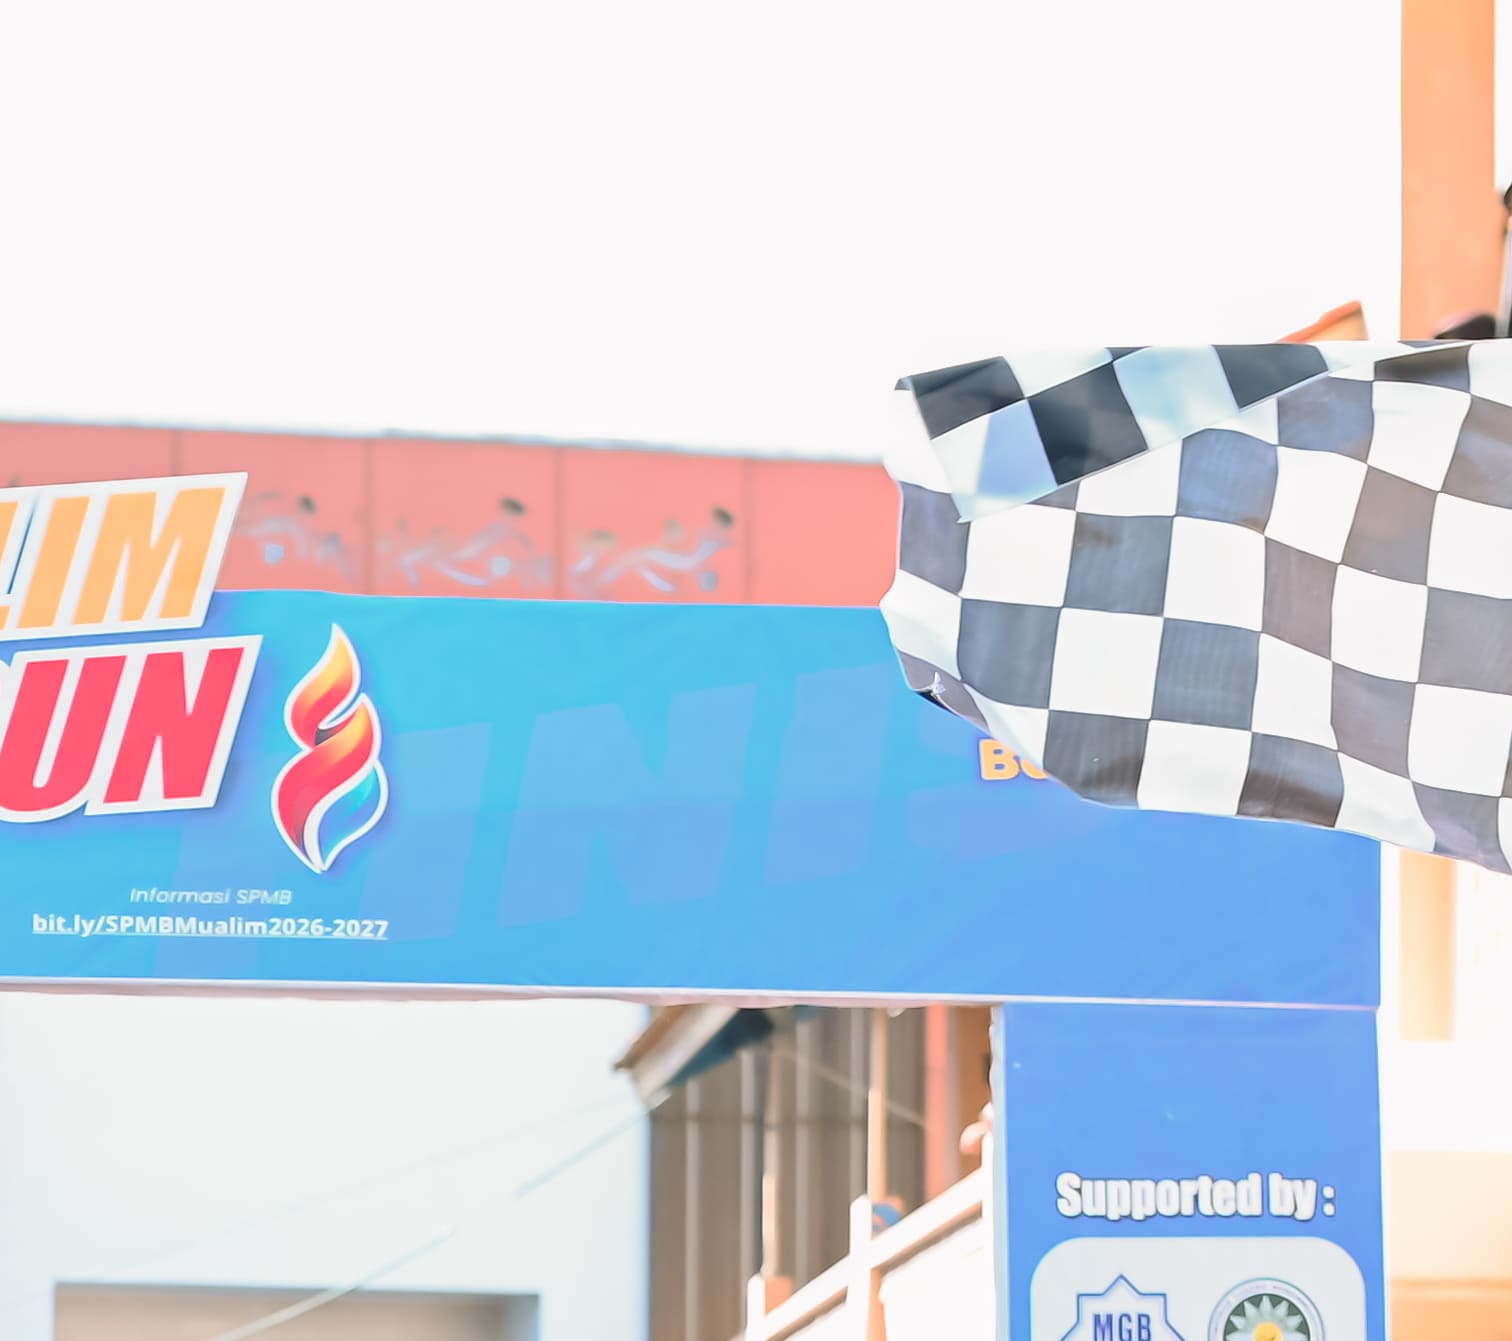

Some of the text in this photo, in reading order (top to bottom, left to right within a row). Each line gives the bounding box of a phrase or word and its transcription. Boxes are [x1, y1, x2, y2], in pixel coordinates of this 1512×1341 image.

[129, 887, 292, 908] Informasi SPMB
[32, 911, 388, 941] bit.ly/SPMBMualim2026-2027
[1056, 1173, 1262, 1220] Supported
[1269, 1172, 1317, 1221] by
